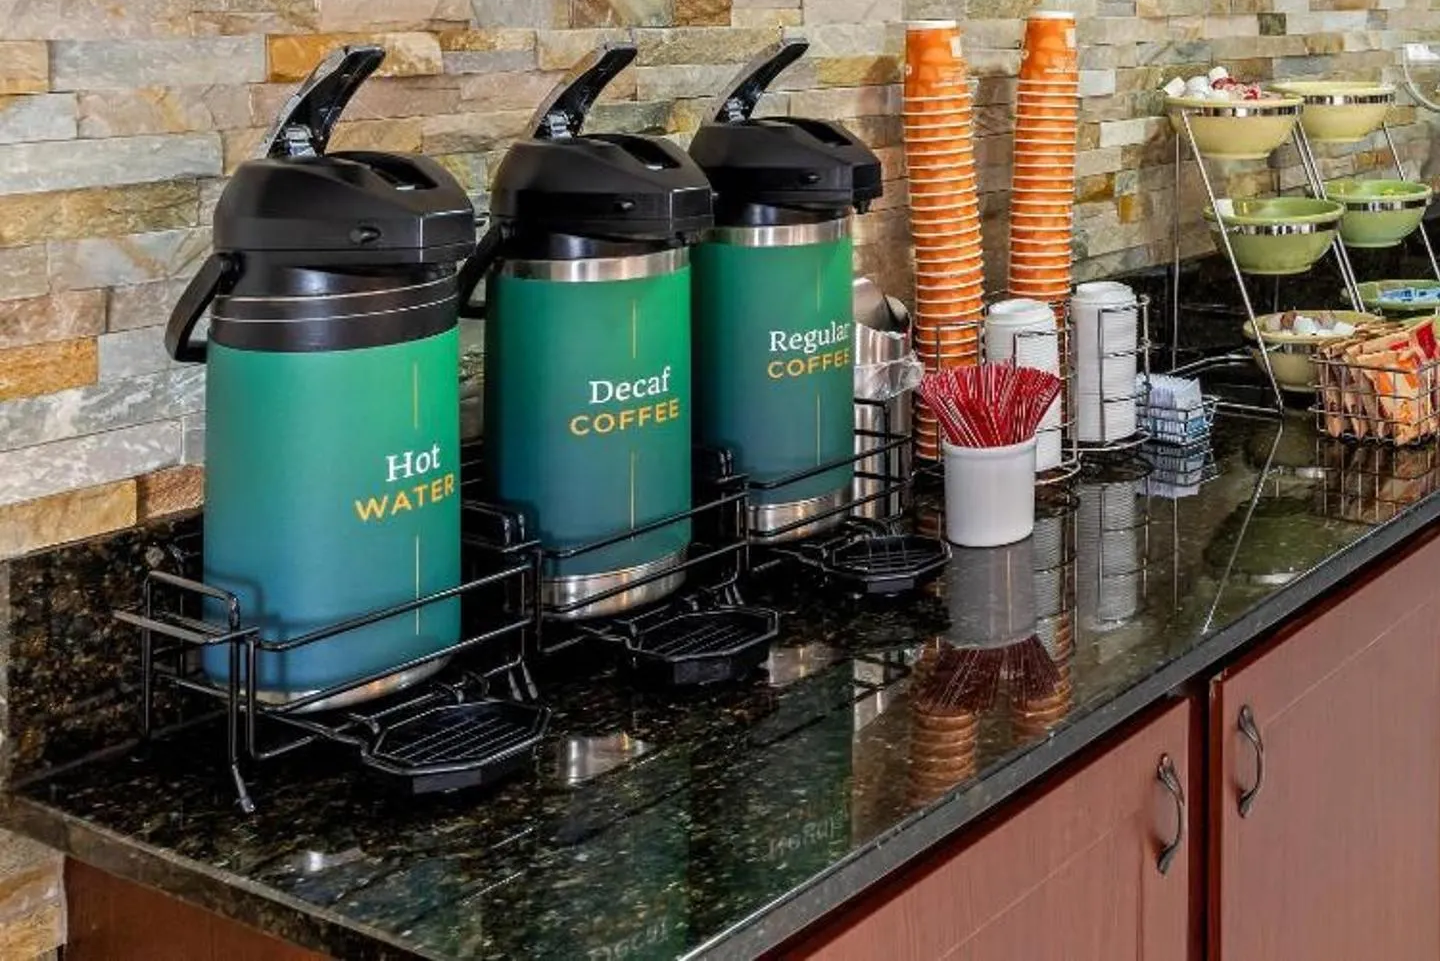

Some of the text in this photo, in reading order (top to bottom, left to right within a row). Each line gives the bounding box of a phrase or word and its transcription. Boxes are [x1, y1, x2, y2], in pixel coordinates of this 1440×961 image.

[769, 321, 850, 353] Regular
[768, 348, 849, 378] COFFEE
[588, 365, 671, 404] Decaf
[569, 398, 679, 436] COFFEE
[385, 443, 440, 482] Hot
[355, 473, 454, 522] WATER
